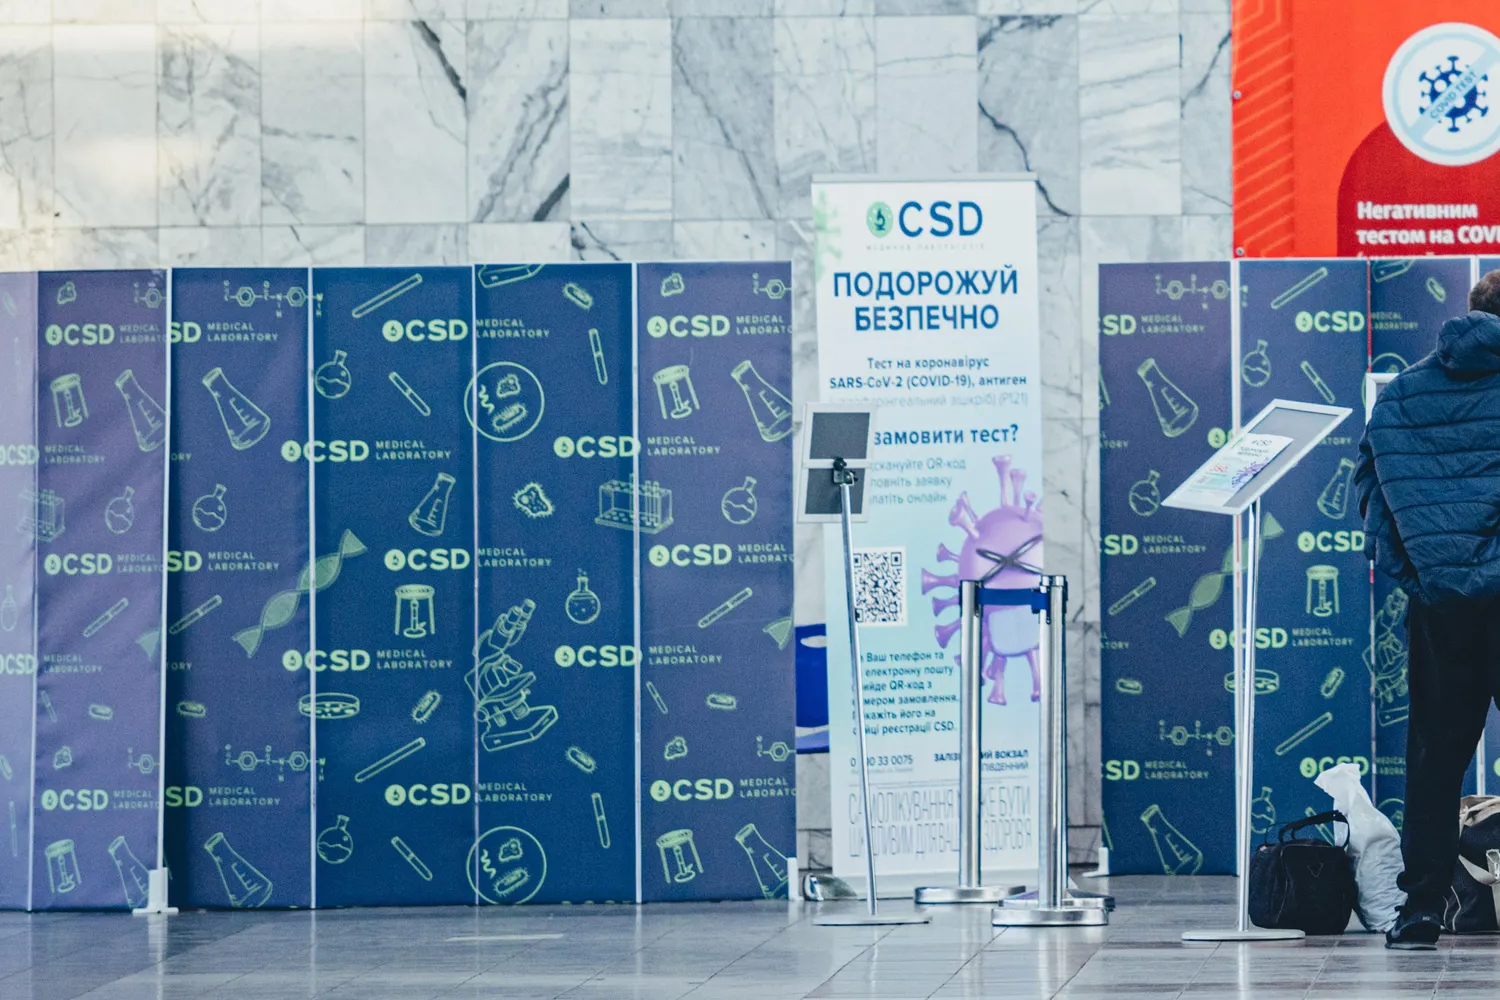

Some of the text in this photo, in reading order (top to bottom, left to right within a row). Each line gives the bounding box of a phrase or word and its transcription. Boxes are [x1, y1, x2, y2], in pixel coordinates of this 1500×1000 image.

[1430, 71, 1477, 119] COVID TEST
[1357, 201, 1478, 219] Негативним
[899, 201, 982, 237] CSD
[1357, 229, 1425, 244] тестом
[1430, 230, 1454, 243] на
[834, 264, 1017, 300] ПОДОРОЖУЙ
[736, 316, 783, 324] MEDICAL
[855, 305, 998, 330] БЕЗПЕЧНО
[1142, 315, 1183, 323] MEDICAL
[1314, 312, 1365, 332] CSD
[208, 323, 253, 331] MEDICAL
[669, 315, 730, 337] CSD
[1099, 314, 1137, 335] SD
[1142, 325, 1204, 333] LABORATORY
[64, 324, 115, 345] CSD
[406, 320, 468, 341] CSD
[476, 330, 549, 338] LABORATORY
[208, 333, 278, 341] LABORATORY
[867, 356, 989, 369] Тест на коронавірус
[830, 375, 1026, 389] SARS-CoV-2 (COVID-19), антиген
[875, 424, 1018, 445] замовити тест?
[376, 441, 425, 449] MEDICAL
[648, 437, 695, 445] MEDICAL
[304, 441, 369, 462] CSD
[577, 436, 641, 457] CSD
[648, 446, 721, 455] LABORATORY
[376, 451, 451, 460] LABORATORY
[927, 458, 966, 469] QR-код
[916, 477, 951, 486] заявку
[907, 493, 947, 503] онлайн
[1100, 535, 1138, 554] SD
[1317, 531, 1365, 551] CSD
[478, 548, 527, 557] MEDICAL
[738, 545, 786, 553] MEDICAL
[1143, 545, 1206, 554] LABORATORY
[209, 552, 254, 560] MEDICAL
[407, 549, 470, 570] CSD
[671, 544, 731, 566] CSD
[62, 554, 112, 574] CSD
[167, 551, 202, 571] SD
[478, 559, 551, 567] LABORATORY
[209, 563, 279, 571] LABORATORY
[1292, 628, 1332, 636] MEDICAL
[1291, 638, 1352, 647] LABORATORY
[377, 650, 426, 658] MEDICAL
[649, 645, 697, 654] MEDICAL
[44, 654, 82, 662] MEDICAL
[305, 649, 370, 671] CSD
[578, 645, 643, 666] CSD
[649, 656, 723, 665] LABORATORY
[867, 651, 944, 662] Ваш телефон та
[44, 665, 102, 673] LABORATORY
[377, 660, 452, 669] LABORATORY
[865, 666, 953, 677] електронну пошту
[890, 680, 924, 690] QR-код
[900, 710, 921, 718] його
[882, 724, 930, 735] реєстрації
[995, 750, 1028, 759] ВОКЗАЛ
[878, 756, 888, 766] 33
[891, 755, 913, 765] 0075
[1145, 761, 1186, 769] MEDICAL
[1102, 760, 1139, 780] SD
[1145, 771, 1208, 779] LABORATORY
[740, 779, 788, 787] MEDICAL
[407, 783, 471, 805] CSD
[672, 779, 734, 799] CSD
[59, 789, 108, 809] CSD
[166, 787, 203, 808] SD
[209, 797, 280, 806] LABORATORY
[479, 793, 552, 801] LABORATORY
